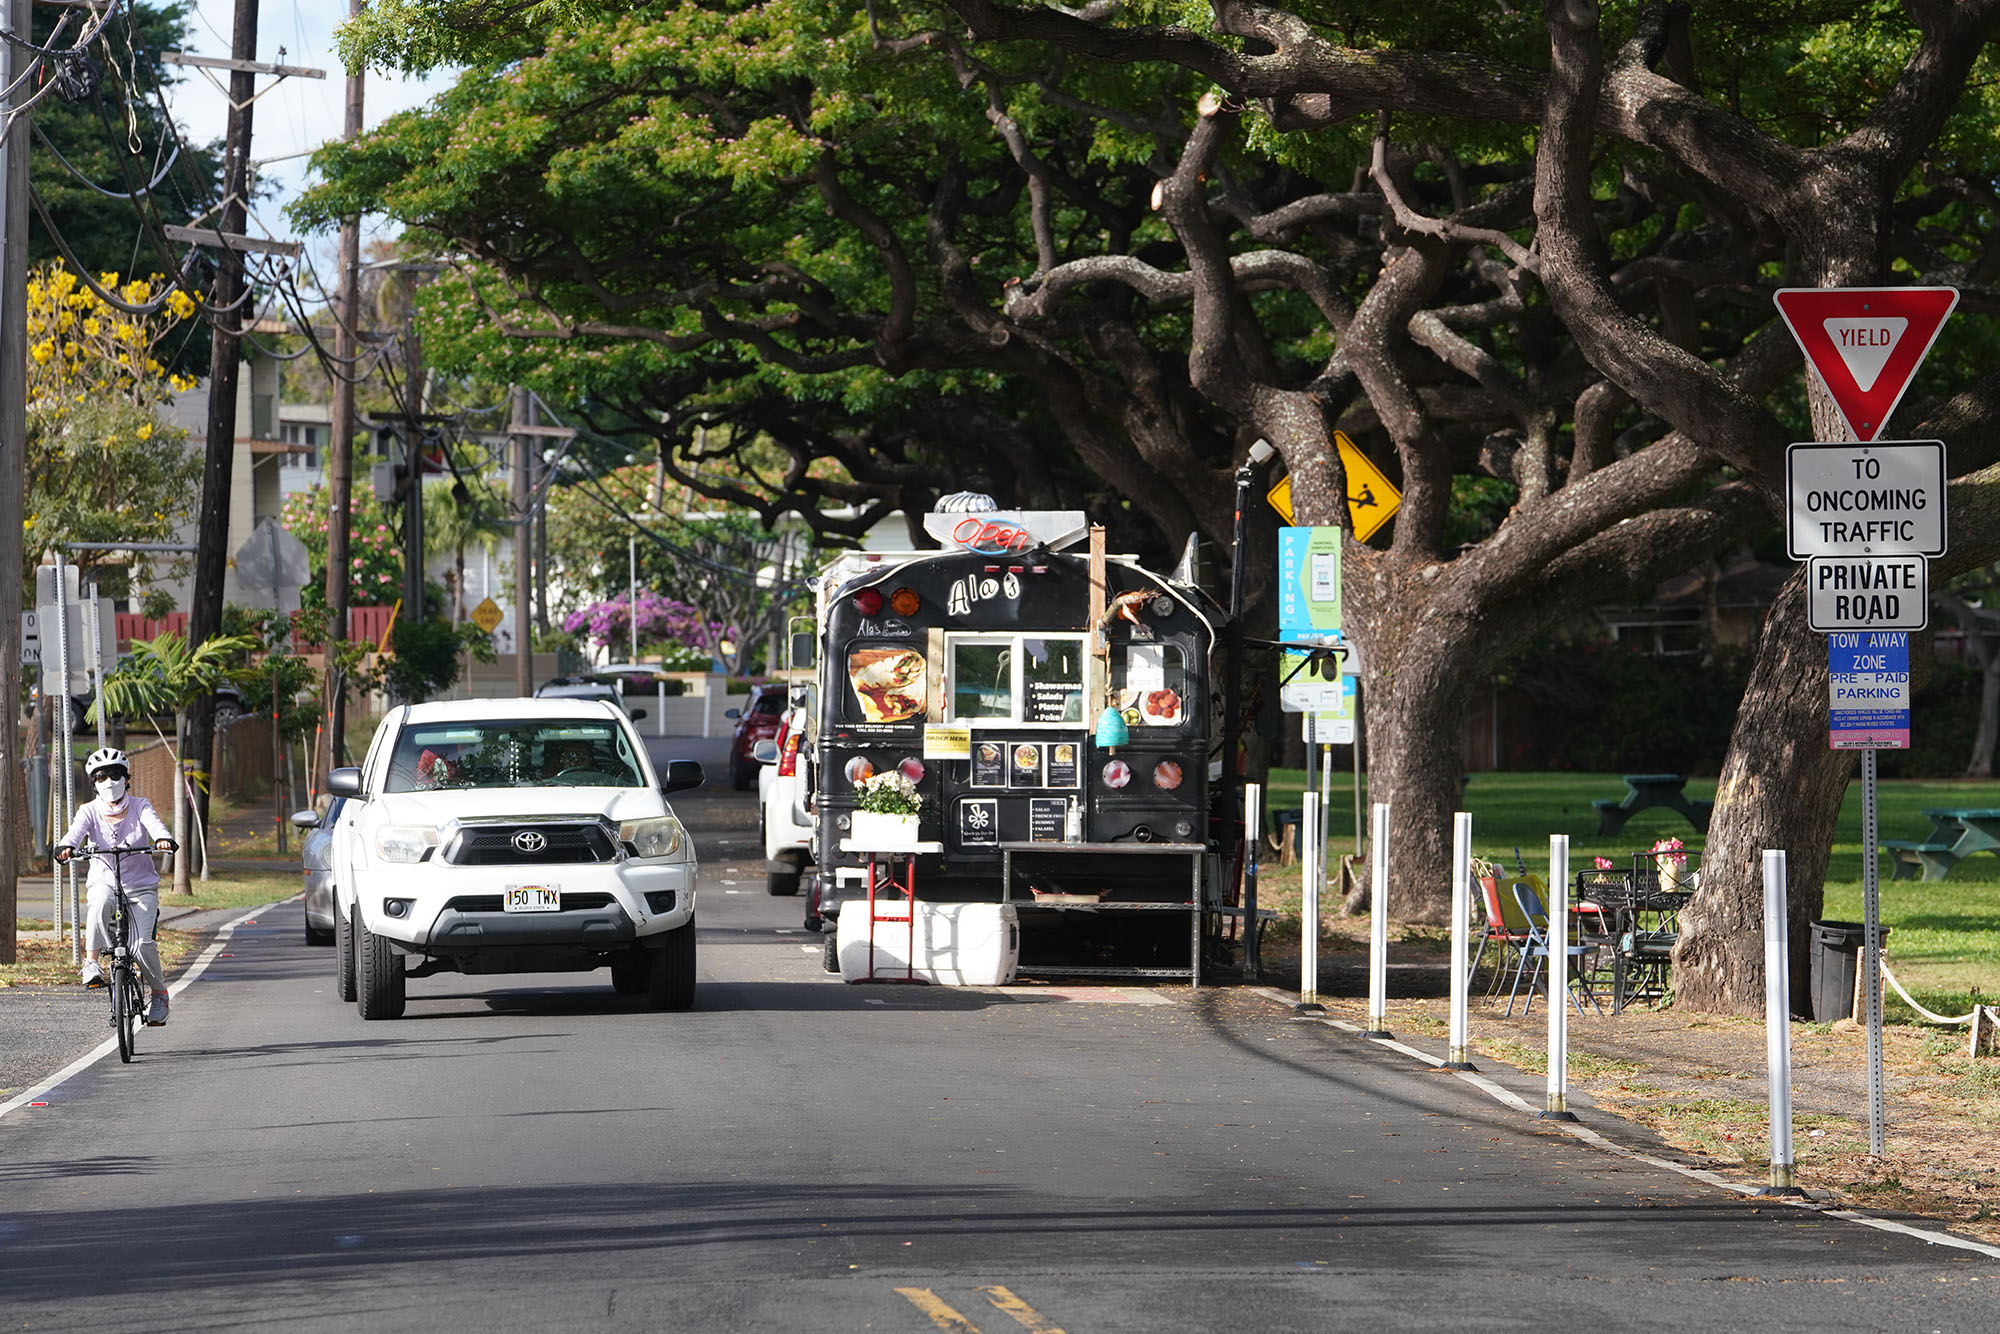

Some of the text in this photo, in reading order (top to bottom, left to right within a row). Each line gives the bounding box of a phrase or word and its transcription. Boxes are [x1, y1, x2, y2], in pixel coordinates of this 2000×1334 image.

[1839, 328, 1891, 346] YIELD
[1851, 458, 1880, 480] TO
[1807, 489, 1927, 512] ONCOMING
[953, 518, 1029, 551] Open
[1819, 520, 1914, 543] TRAFFIC
[1284, 536, 1295, 614] PARKING
[1818, 564, 1916, 590] PRIVATE
[947, 571, 1020, 616] Ala's
[1835, 595, 1899, 620] ROAD
[1830, 632, 1907, 649] TOW AWAY
[1852, 655, 1886, 670] ZONE
[1034, 682, 1082, 690] Shawarmas
[1830, 673, 1858, 684] PRE
[1875, 672, 1908, 683] PAID
[1036, 692, 1064, 700] Salads
[1837, 687, 1901, 699] PARKING
[1038, 703, 1064, 711] Plates
[1040, 713, 1061, 721] Poke
[508, 889, 558, 905] 150 TWX
